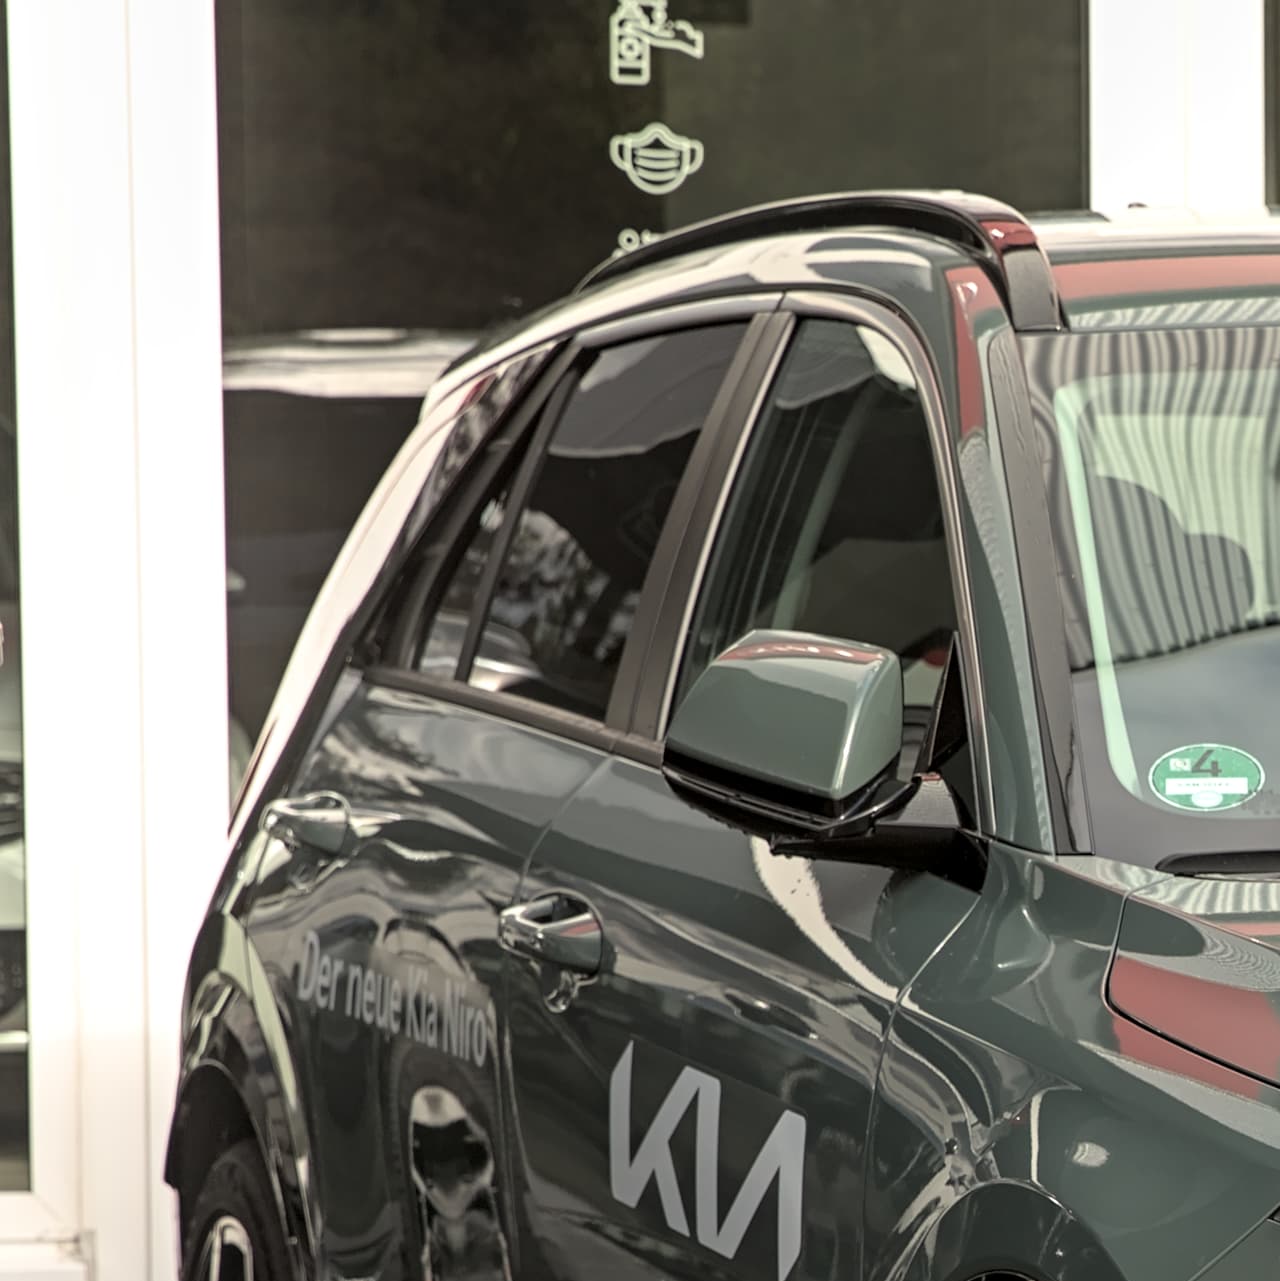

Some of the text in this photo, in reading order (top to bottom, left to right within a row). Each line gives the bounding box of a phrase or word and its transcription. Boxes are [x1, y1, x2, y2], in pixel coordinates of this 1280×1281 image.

[1191, 749, 1222, 777] 4
[297, 929, 488, 1068] Der neue Kia Niro
